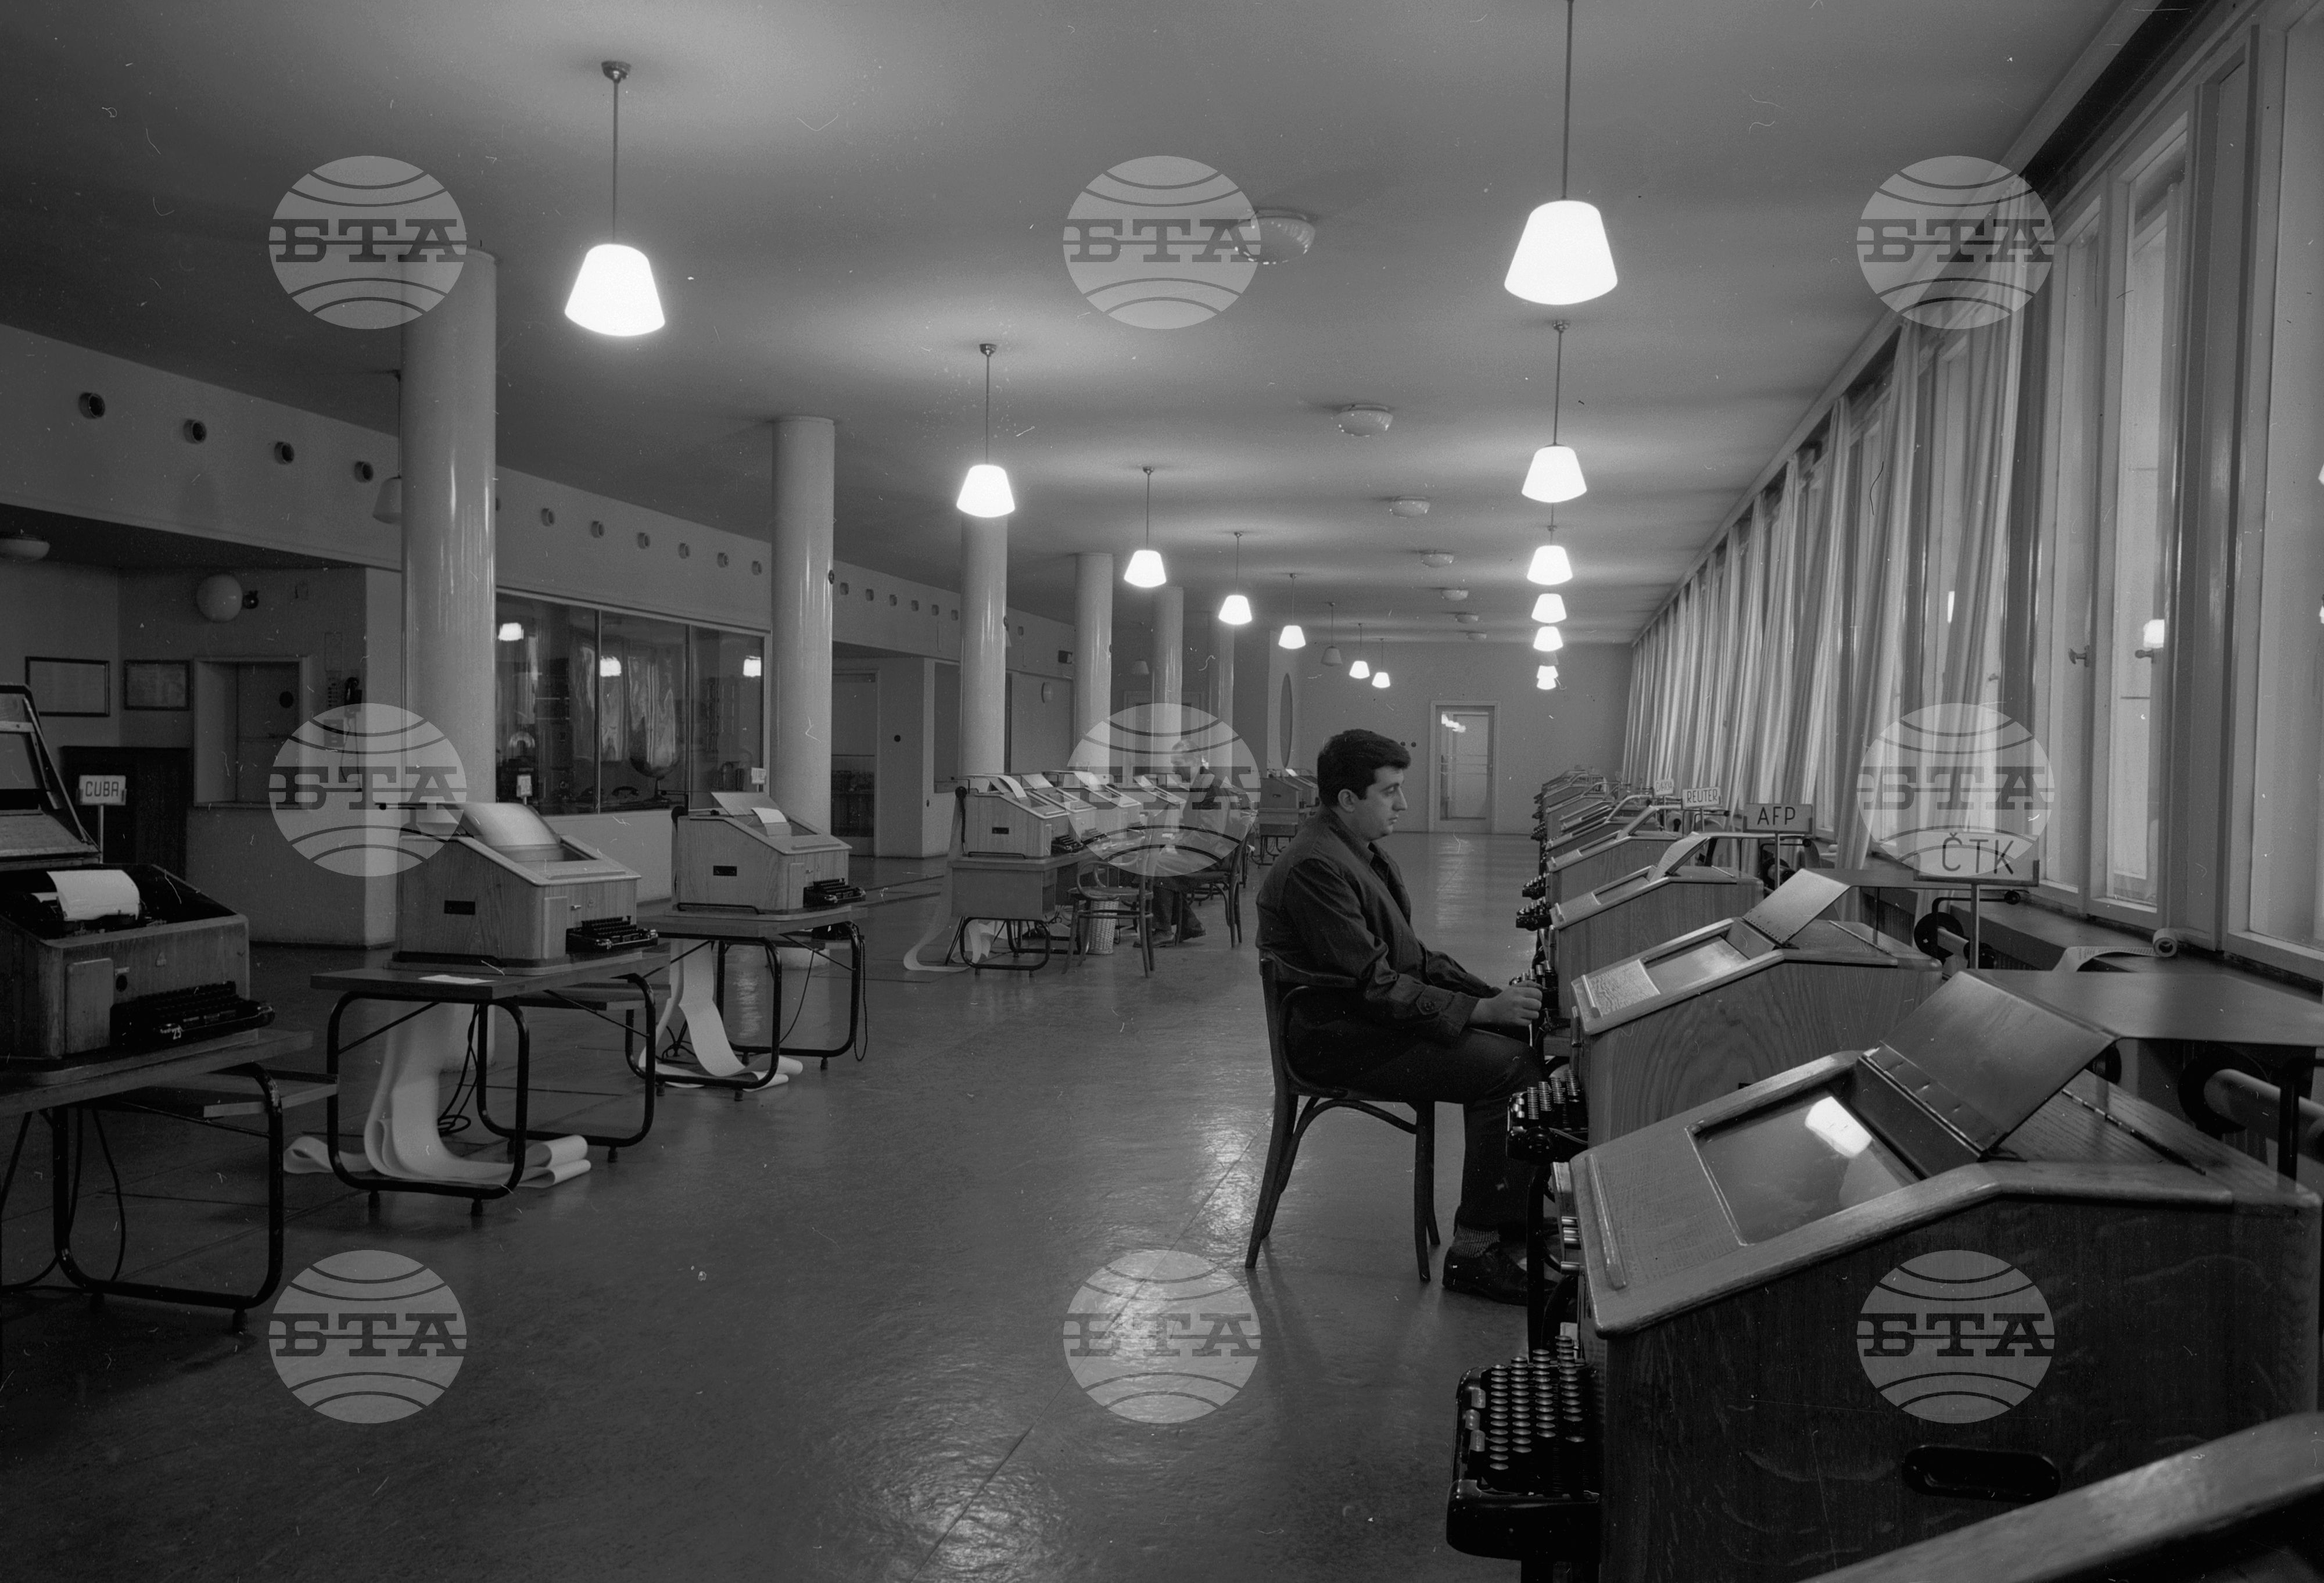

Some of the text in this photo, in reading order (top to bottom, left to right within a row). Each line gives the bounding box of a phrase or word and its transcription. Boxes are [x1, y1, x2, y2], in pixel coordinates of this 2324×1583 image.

[85, 780, 119, 797] CUBA
[1687, 789, 1717, 803] REUTER
[1757, 806, 1796, 825] AFP
[1942, 832, 2014, 875] ČTK
